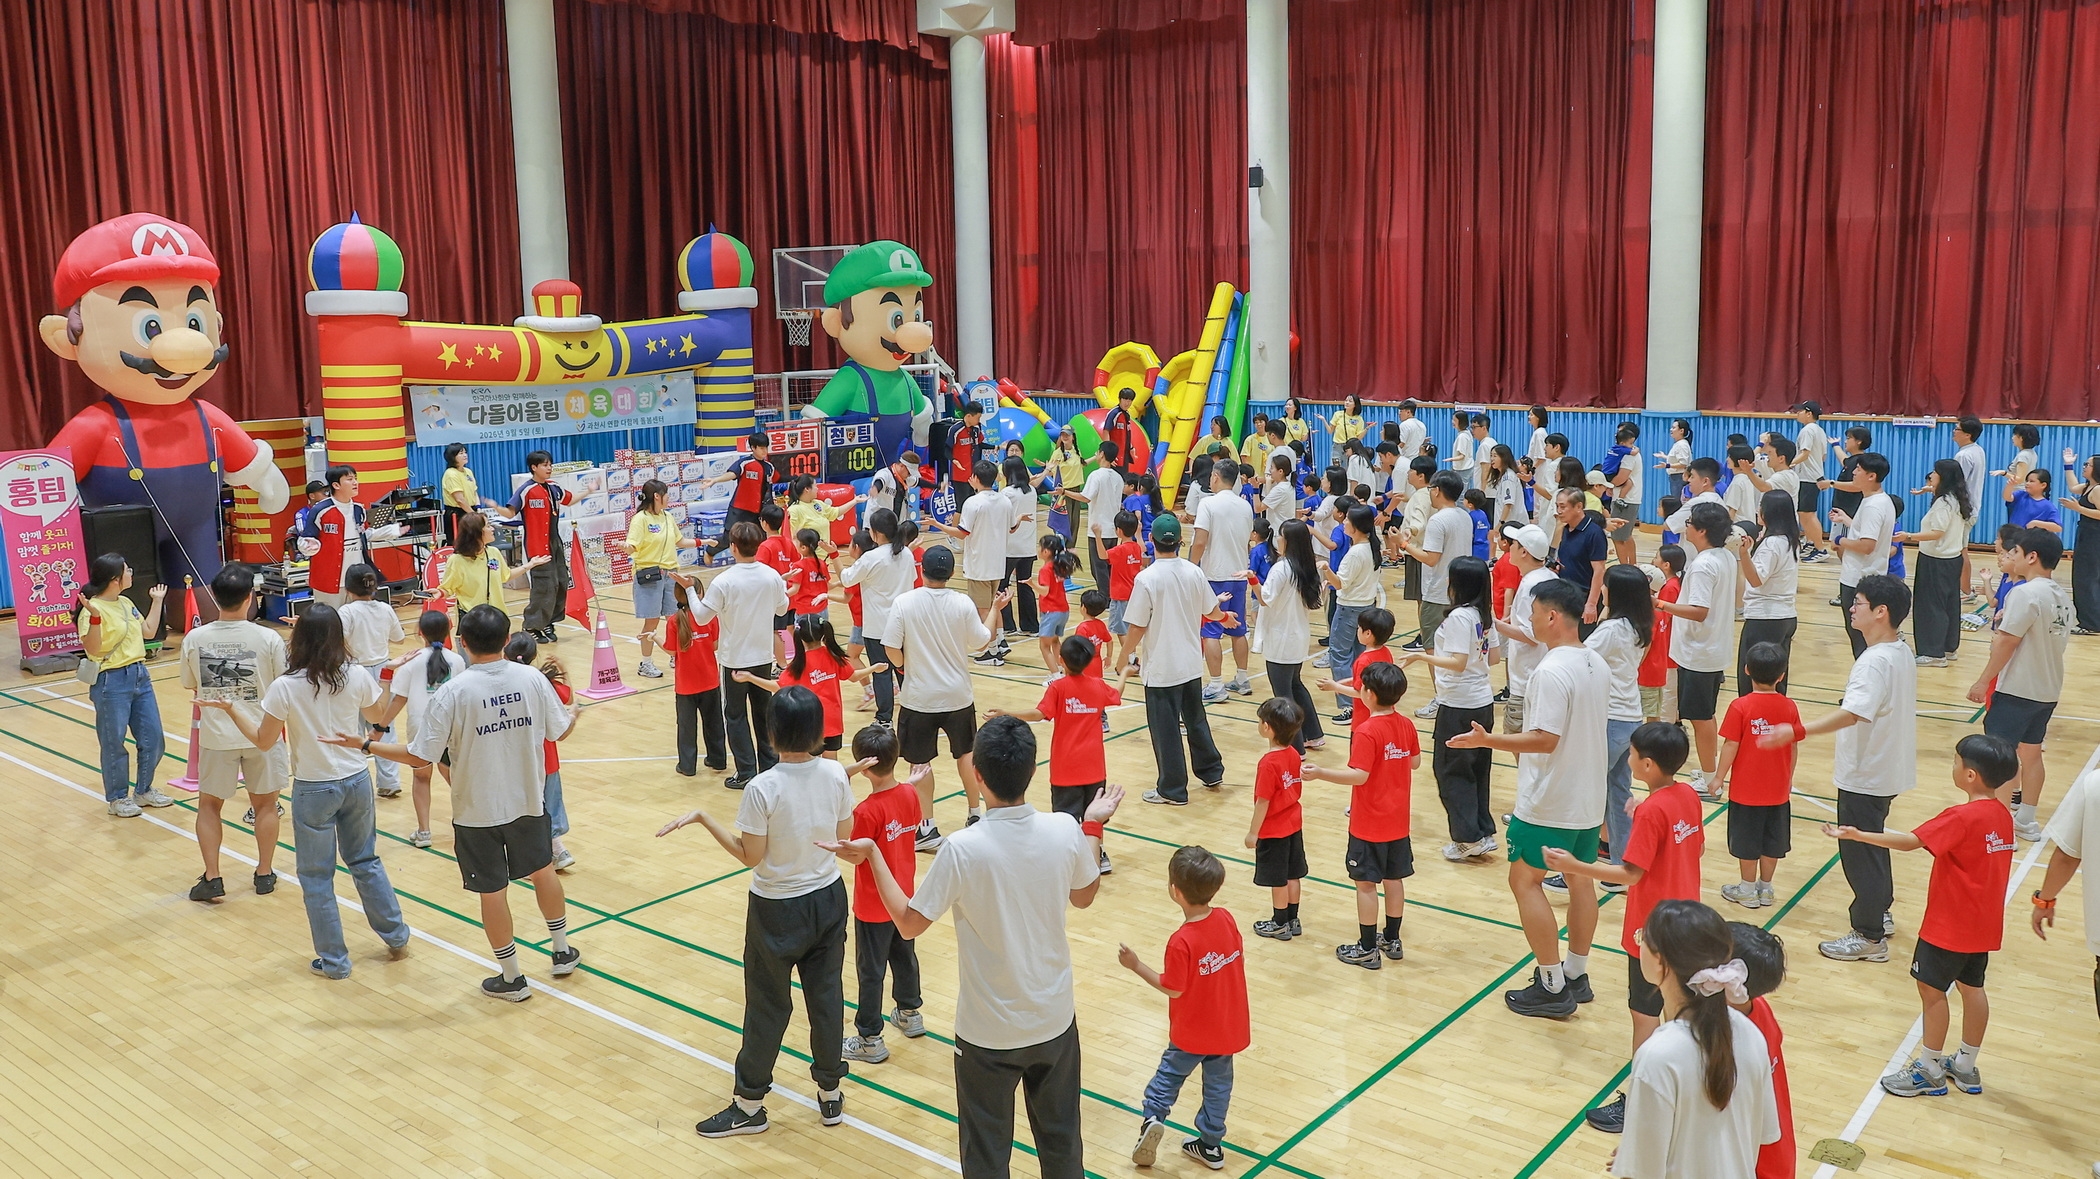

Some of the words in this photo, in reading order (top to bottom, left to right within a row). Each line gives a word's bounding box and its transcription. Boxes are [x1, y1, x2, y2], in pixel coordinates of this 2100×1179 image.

[141, 229, 184, 255] M
[899, 254, 911, 268] L
[468, 400, 559, 425] 다돌어울림
[570, 392, 653, 414] 체육대회
[480, 430, 504, 439] 2026년
[505, 428, 517, 437] 9월
[519, 427, 530, 436] 5일
[532, 427, 545, 436] (토)
[587, 421, 606, 430] 과천시
[790, 452, 819, 476] 100
[848, 446, 875, 471] 100
[8, 477, 66, 507] 홍팀
[933, 493, 957, 515] 청팀
[19, 530, 42, 543] 함께
[44, 528, 68, 540] 웃고!
[17, 545, 39, 558] 맘껏
[40, 541, 74, 555] 즐기자!
[37, 603, 70, 613] Fighting
[27, 611, 73, 628] 화이팅
[482, 699, 487, 708] I
[490, 692, 522, 707] NEED
[499, 708, 508, 718] A
[476, 717, 532, 736] VACATION
